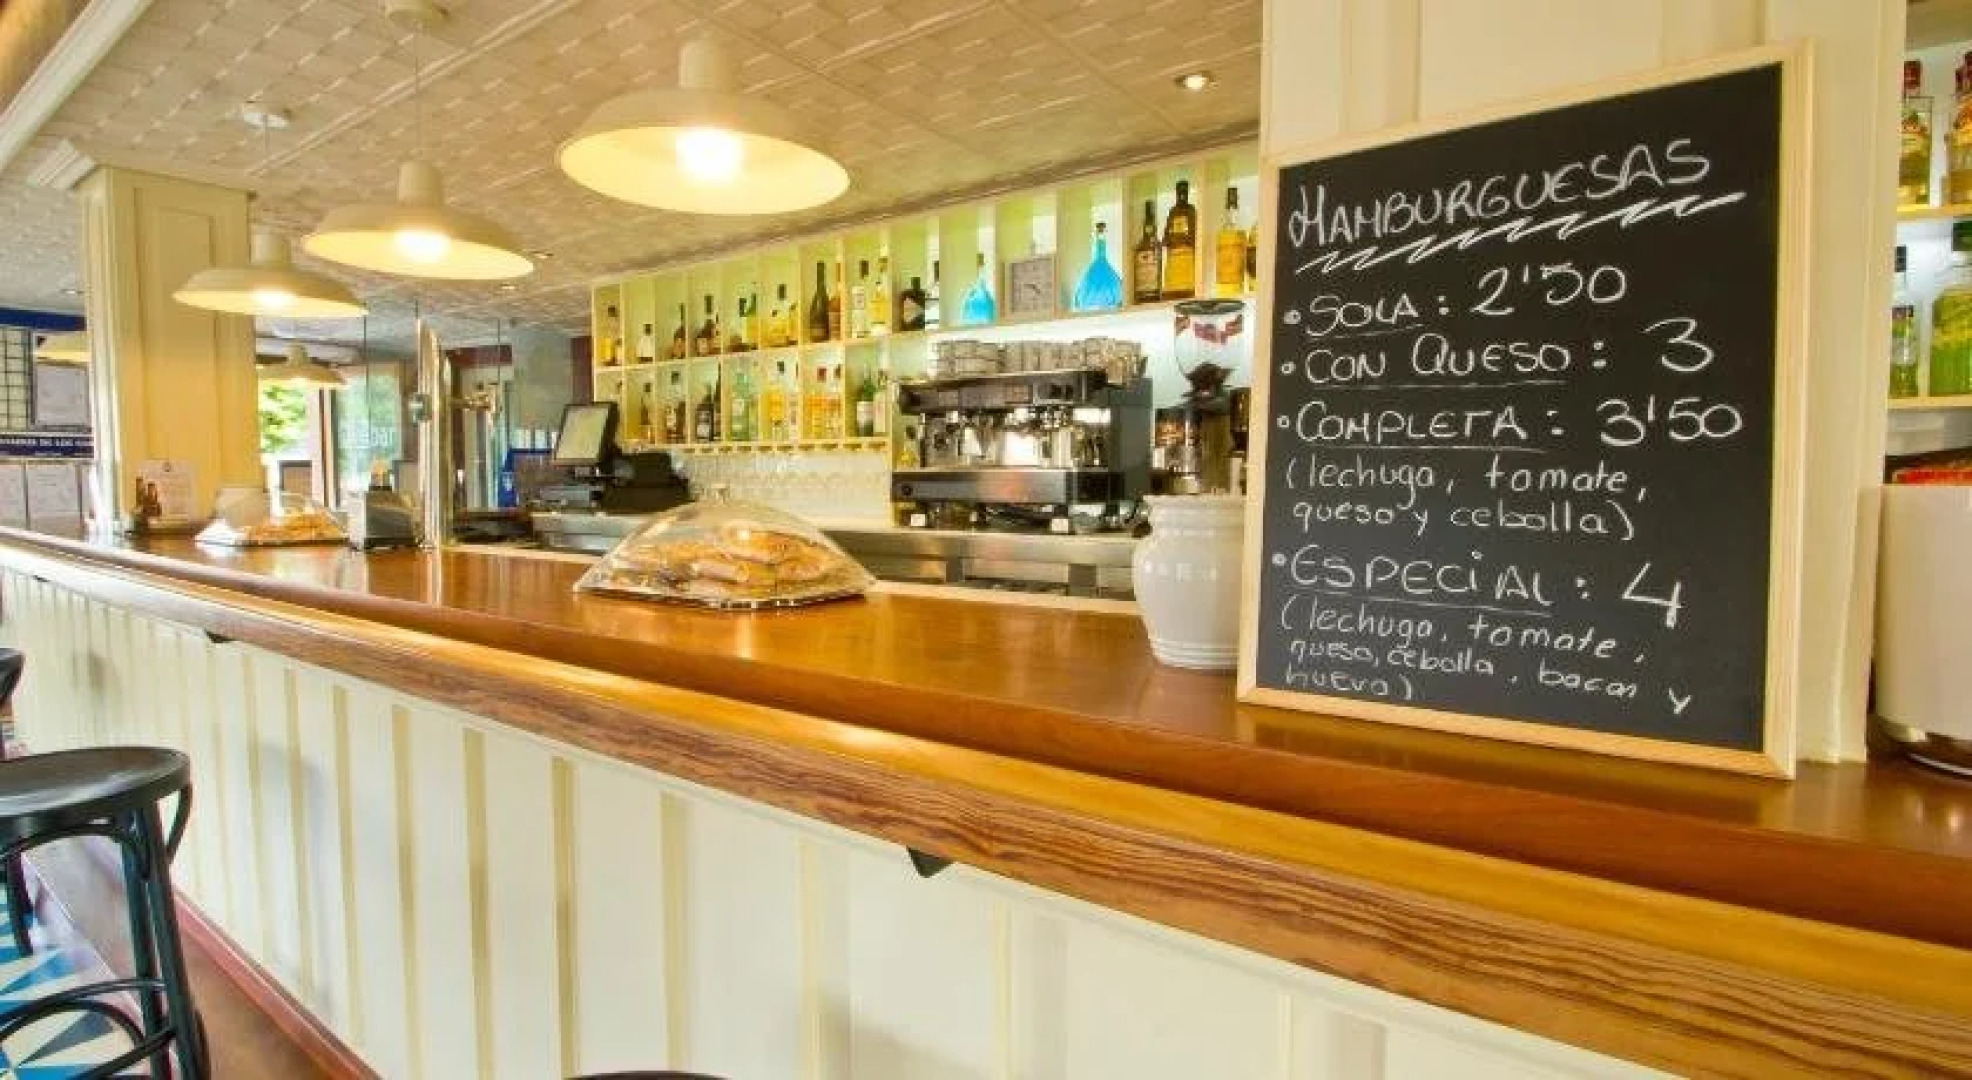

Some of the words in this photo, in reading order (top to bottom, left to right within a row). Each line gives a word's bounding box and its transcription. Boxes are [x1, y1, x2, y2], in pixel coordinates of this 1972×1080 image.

[1288, 138, 1711, 248] HAMBURGUESAS
[1305, 348, 1386, 383] CON
[1642, 317, 1714, 372] 3
[1293, 501, 1394, 534] queso
[1411, 508, 1429, 536] y
[1621, 563, 1683, 628] 4
